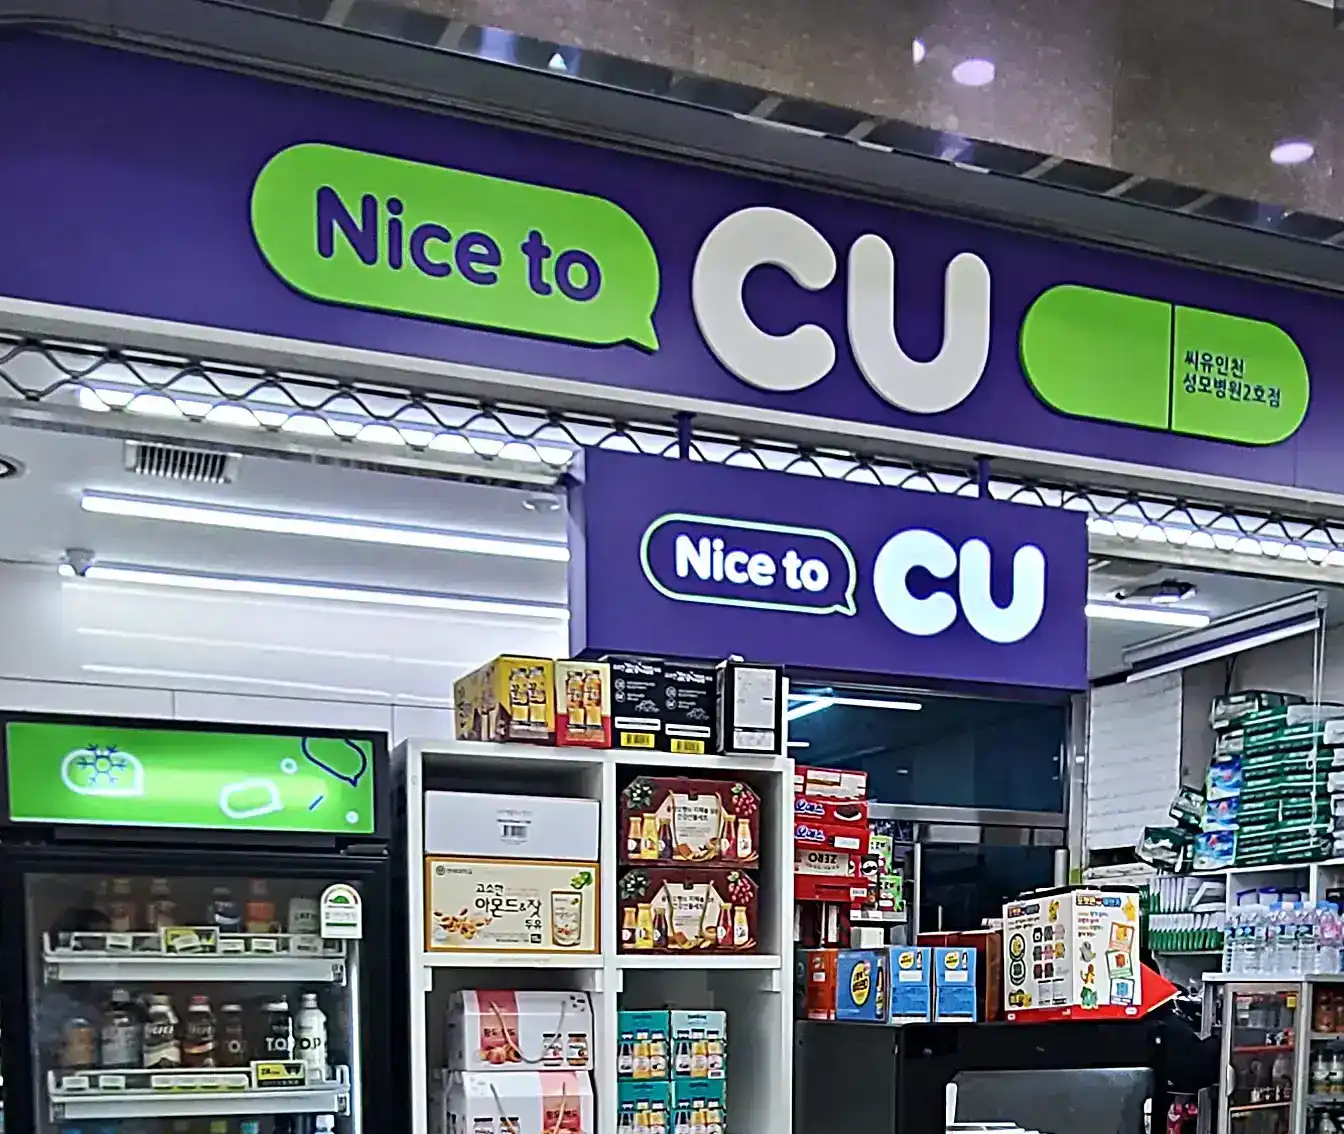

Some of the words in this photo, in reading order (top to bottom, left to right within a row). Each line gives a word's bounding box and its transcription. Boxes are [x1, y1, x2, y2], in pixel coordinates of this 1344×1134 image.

[314, 185, 502, 289] Nice
[522, 228, 603, 302] to
[690, 206, 992, 414] CU
[1183, 350, 1245, 380] 씨유인천
[1183, 372, 1281, 409] 성모병원2호점
[674, 534, 777, 587] Nice
[782, 546, 830, 595] to
[872, 528, 1046, 644] CU
[475, 883, 504, 897] 고소한
